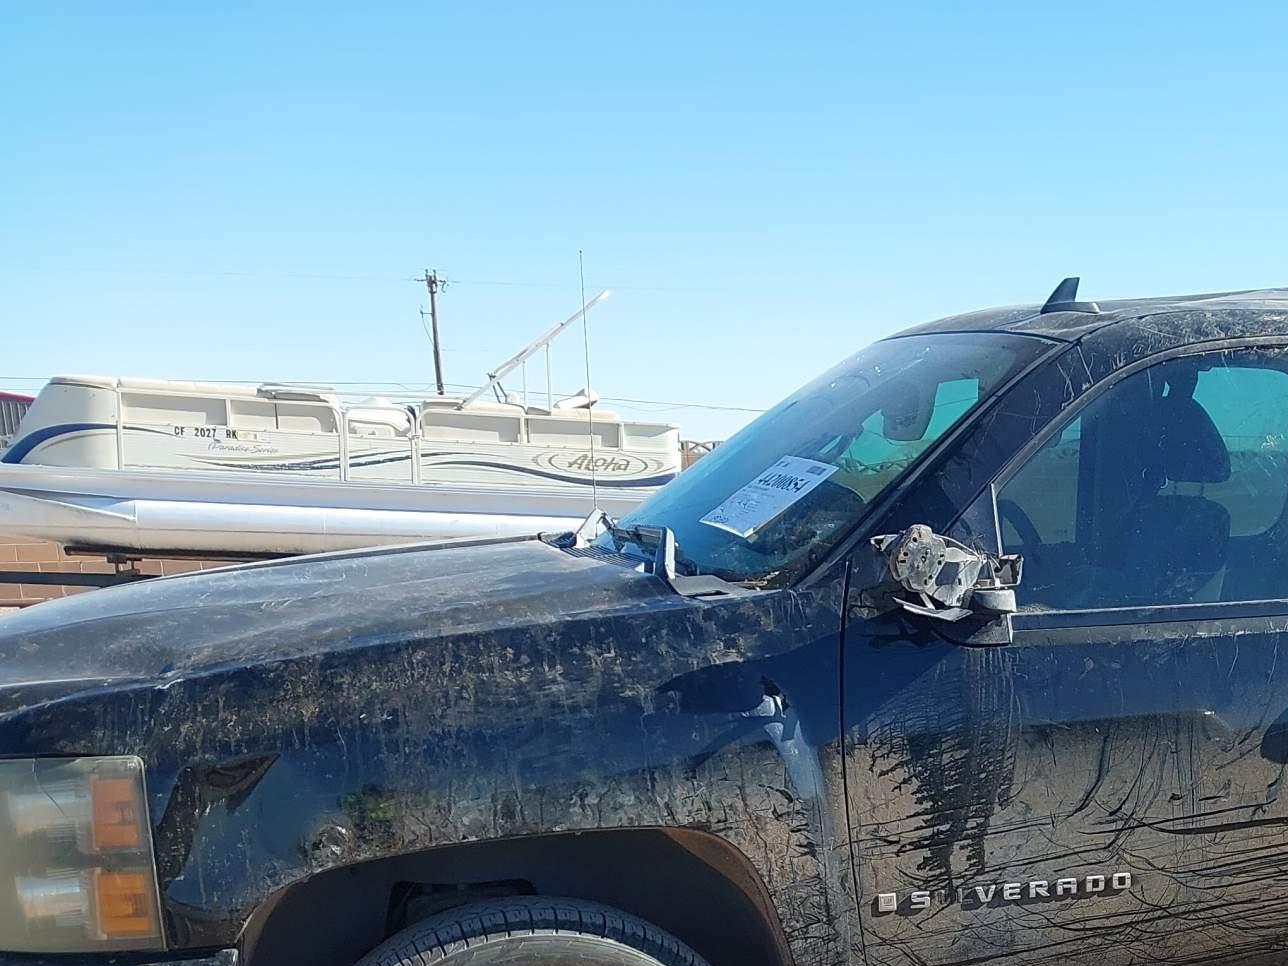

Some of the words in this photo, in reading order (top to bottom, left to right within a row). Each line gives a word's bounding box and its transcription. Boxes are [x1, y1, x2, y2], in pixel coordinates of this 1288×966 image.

[174, 426, 185, 436] CF
[194, 427, 217, 438] 2027
[226, 429, 238, 440] RK
[910, 872, 1132, 909] SLVERADO
